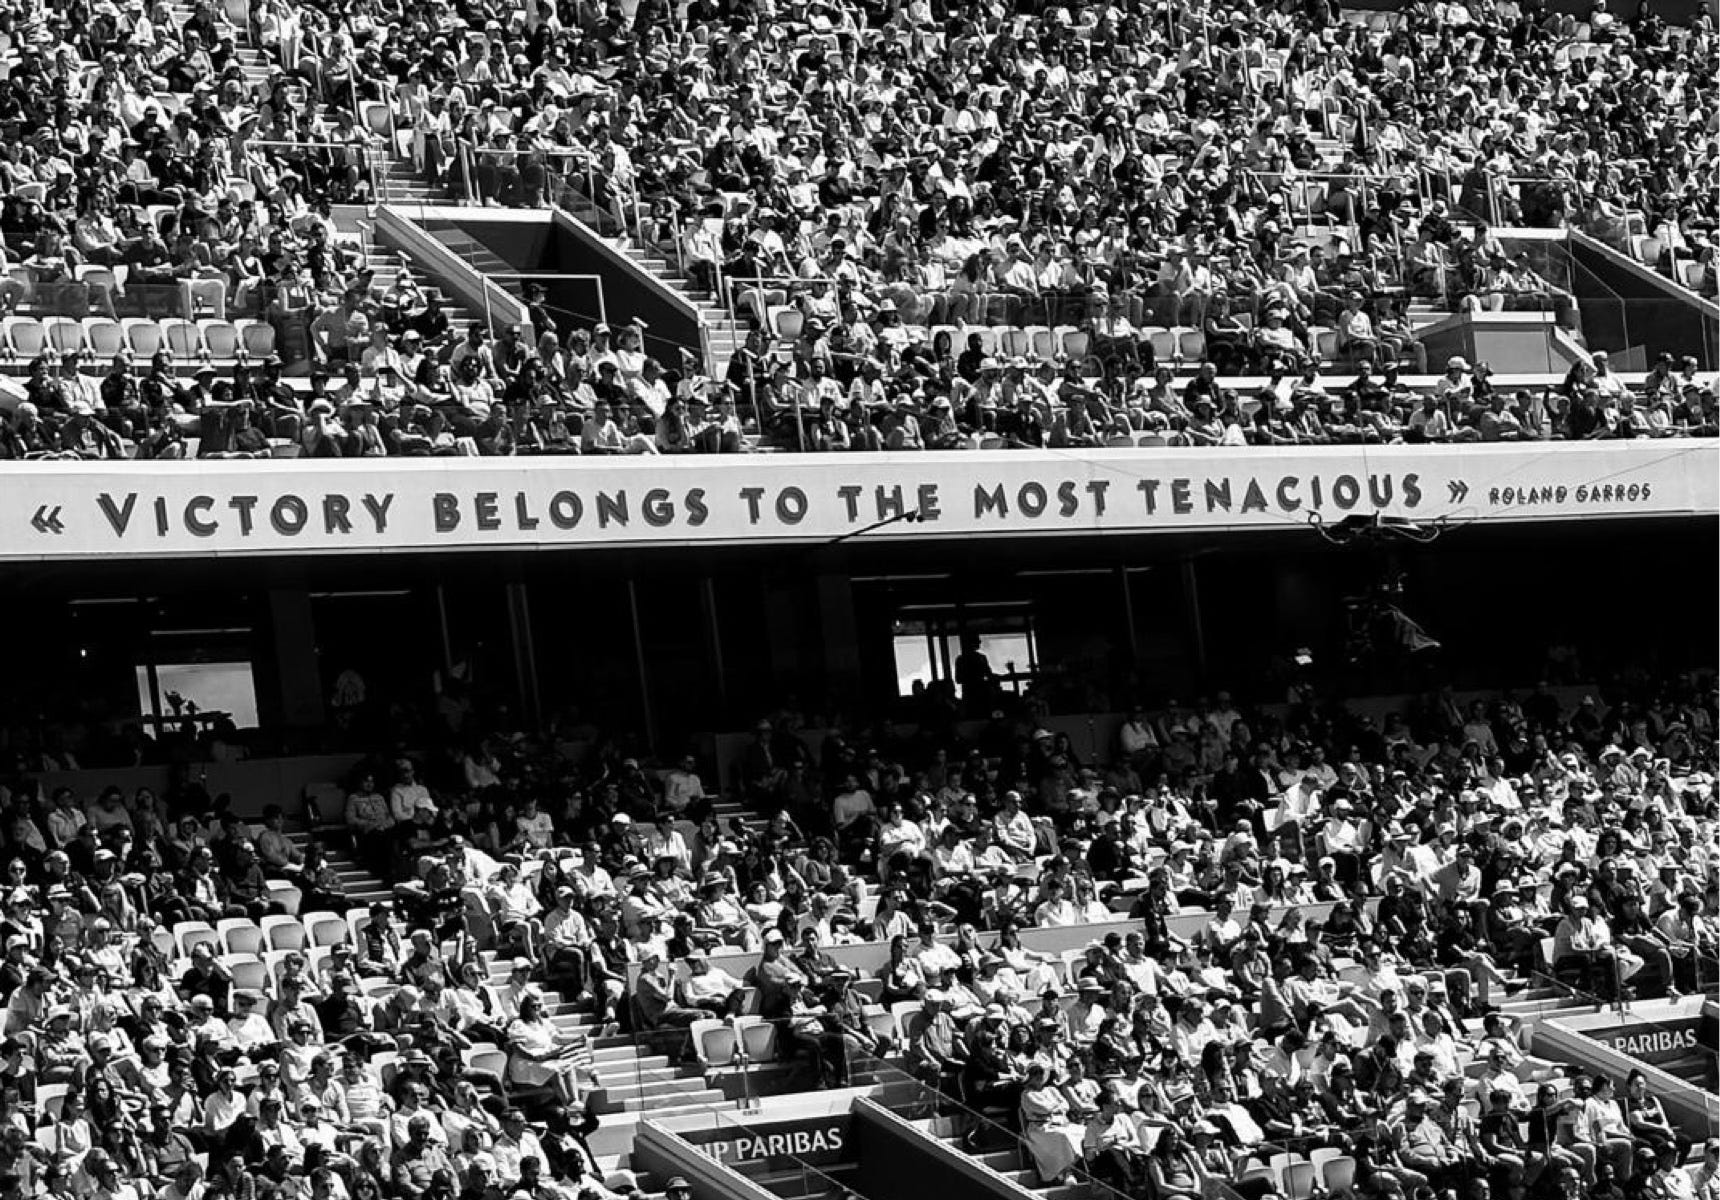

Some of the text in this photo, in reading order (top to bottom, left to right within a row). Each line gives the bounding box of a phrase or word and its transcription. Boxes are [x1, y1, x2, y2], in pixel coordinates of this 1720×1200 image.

[96, 492, 394, 538] VICTORY
[433, 488, 709, 533] BELONGS
[739, 486, 809, 526] TO
[837, 484, 942, 522] THE
[973, 479, 1110, 519] MOST
[1136, 473, 1422, 516] TENACIOUS
[1489, 482, 1651, 505] ROLAND GARROS
[1615, 1028, 1698, 1054] PARIBAS
[735, 1127, 843, 1160] PARIBAS
